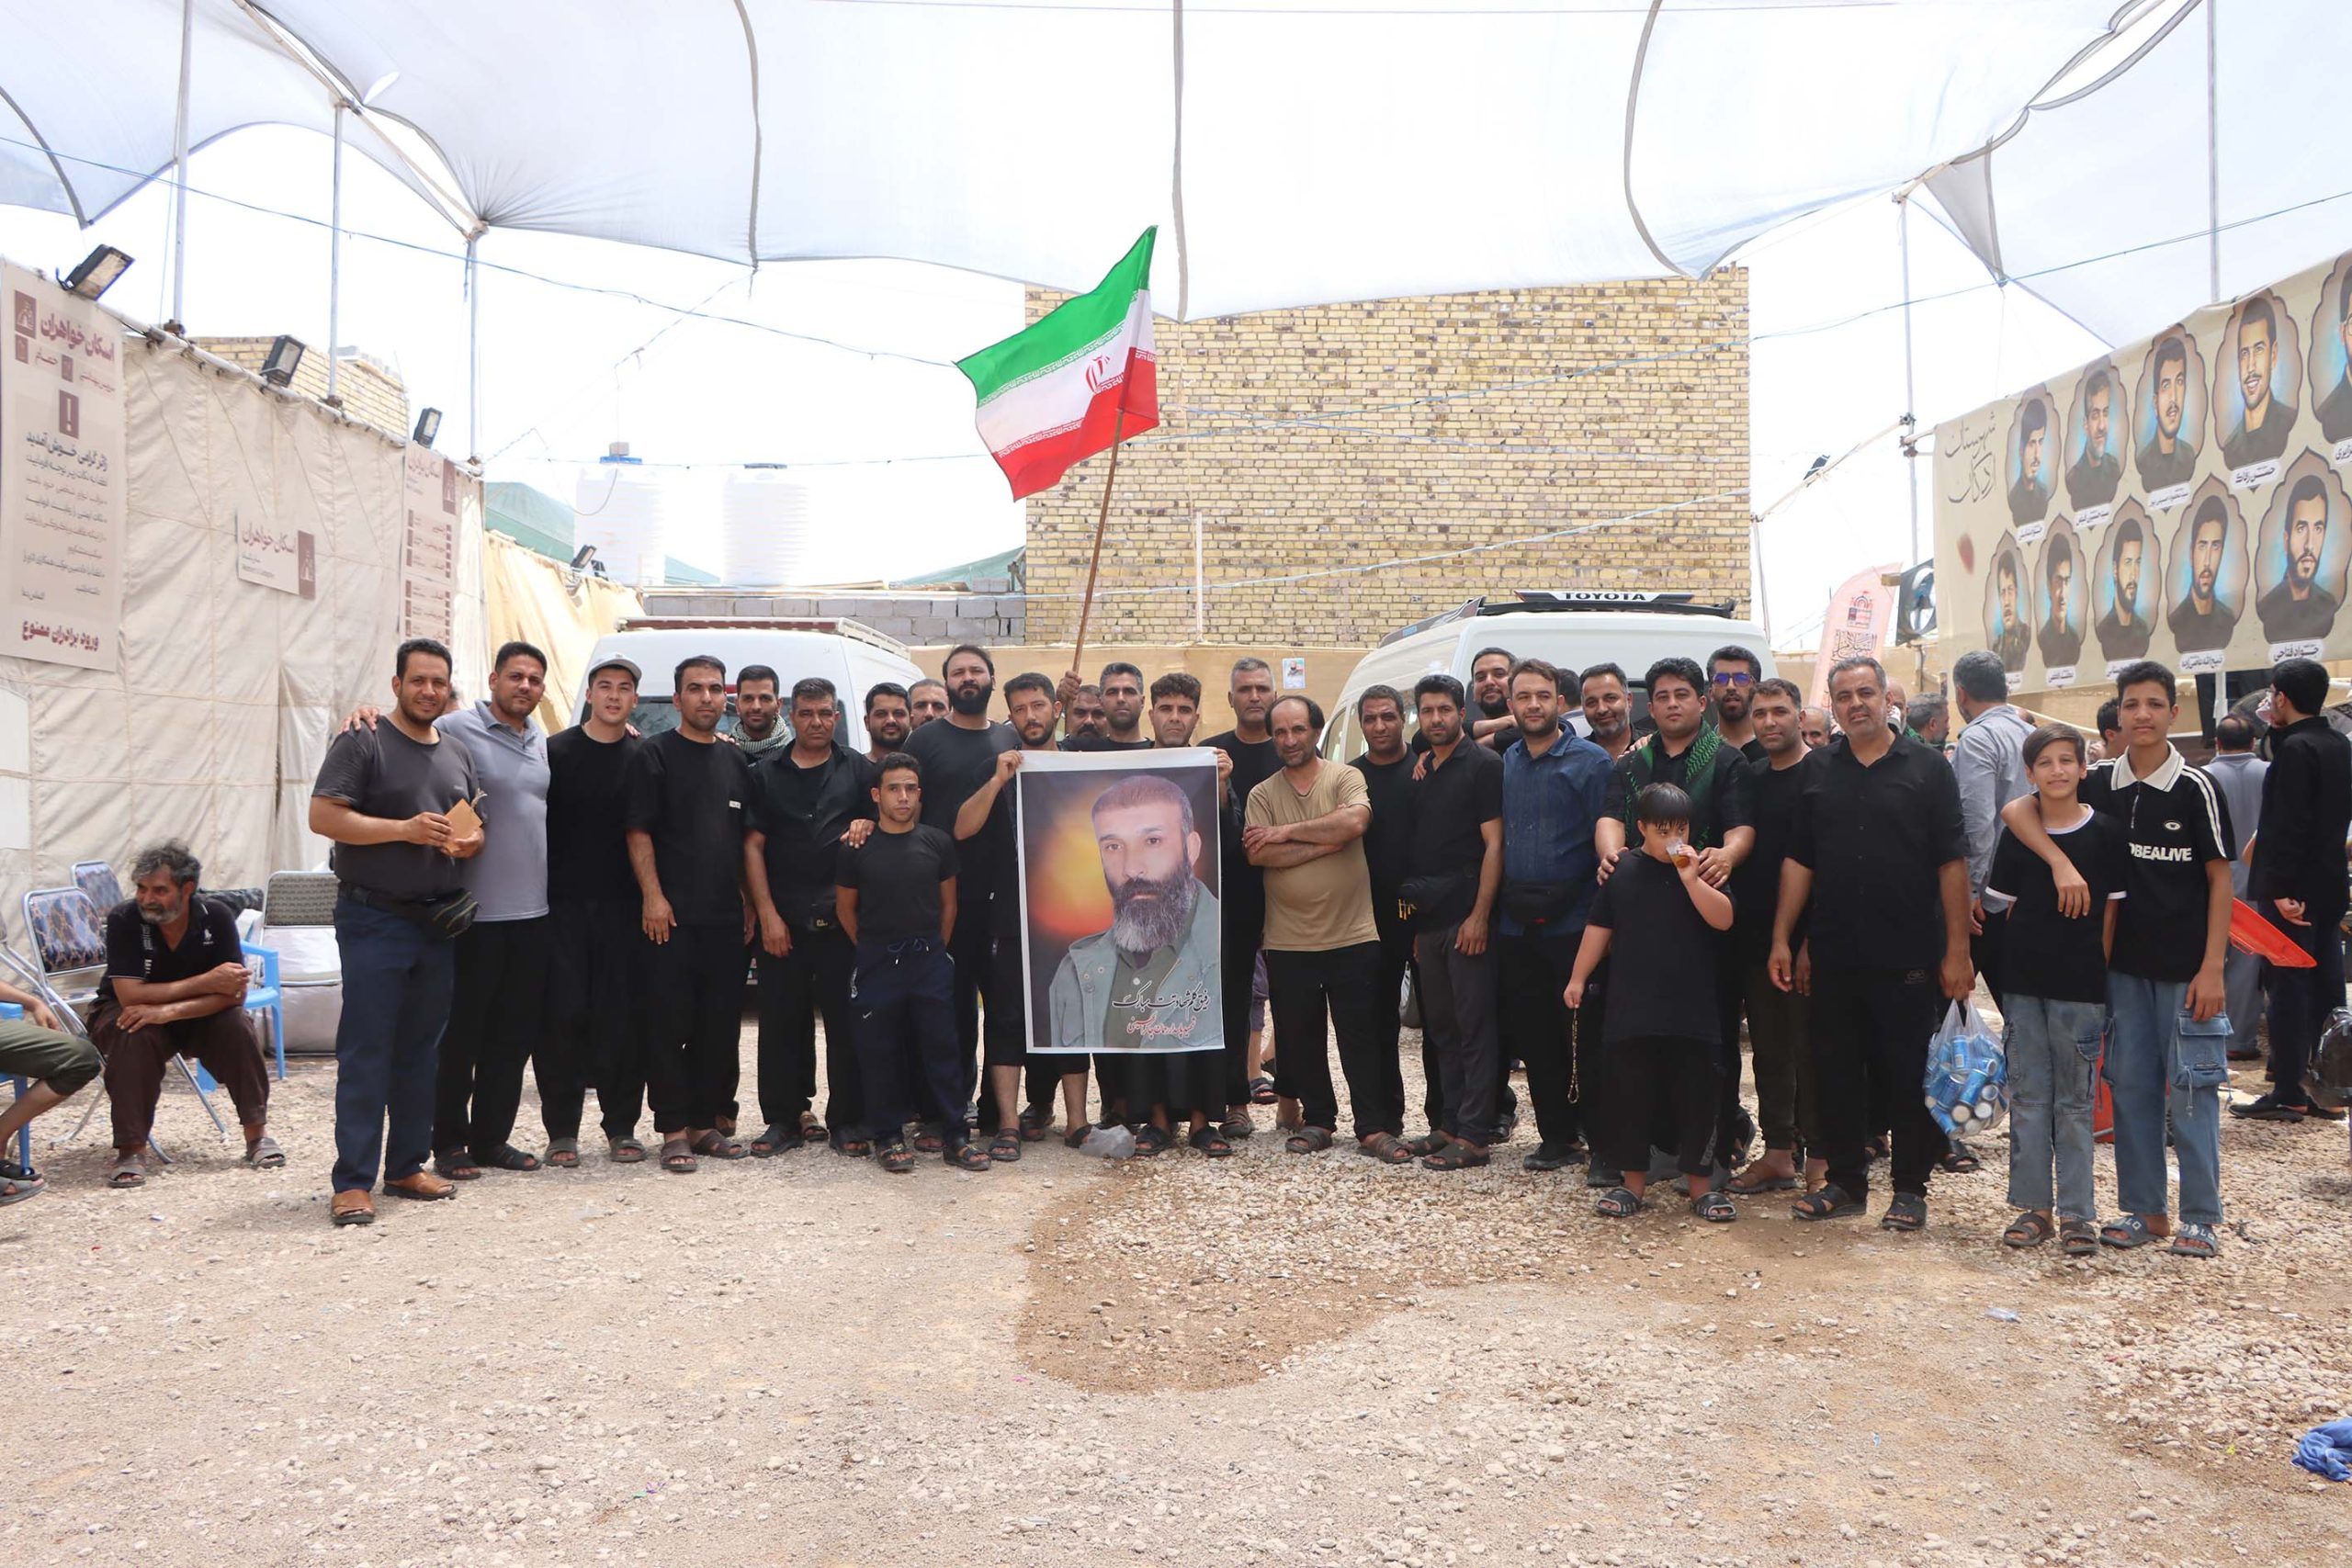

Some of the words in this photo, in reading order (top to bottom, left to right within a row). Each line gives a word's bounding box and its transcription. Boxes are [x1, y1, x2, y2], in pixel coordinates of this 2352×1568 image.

[40, 312, 85, 350] خواهران
[85, 333, 115, 361] اسکان
[1945, 411, 1996, 459] شهرستان
[1947, 451, 1996, 503] اردکان
[242, 521, 275, 551] خواهران
[1563, 592, 1646, 601] TOYOTA
[1193, 988, 1210, 1013] رفیق
